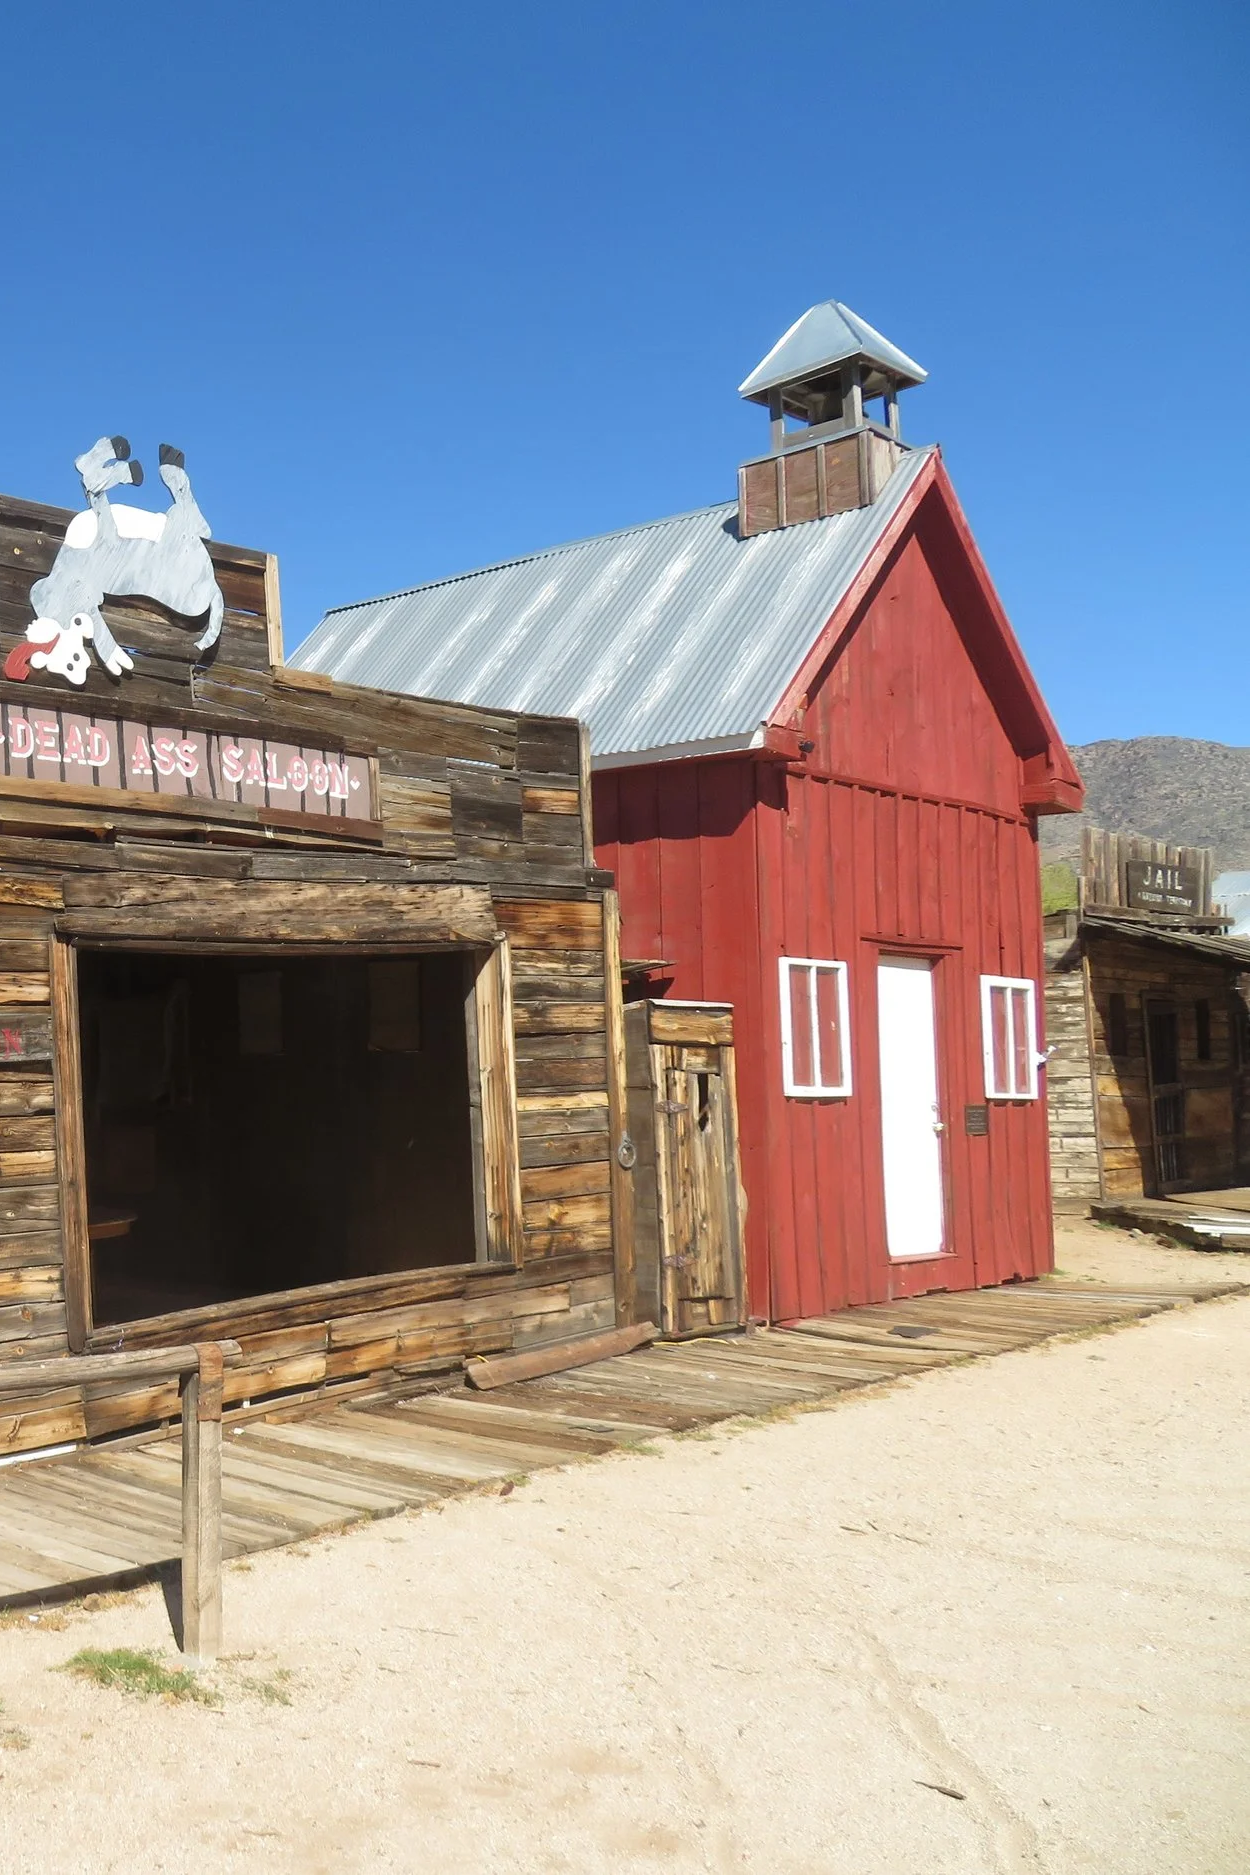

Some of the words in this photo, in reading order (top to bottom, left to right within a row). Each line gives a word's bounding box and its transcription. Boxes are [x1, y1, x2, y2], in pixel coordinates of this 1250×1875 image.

[8, 716, 111, 768] DEAD
[131, 734, 200, 779] ASS
[221, 743, 351, 800] SALOON
[1142, 865, 1184, 891] JAIL
